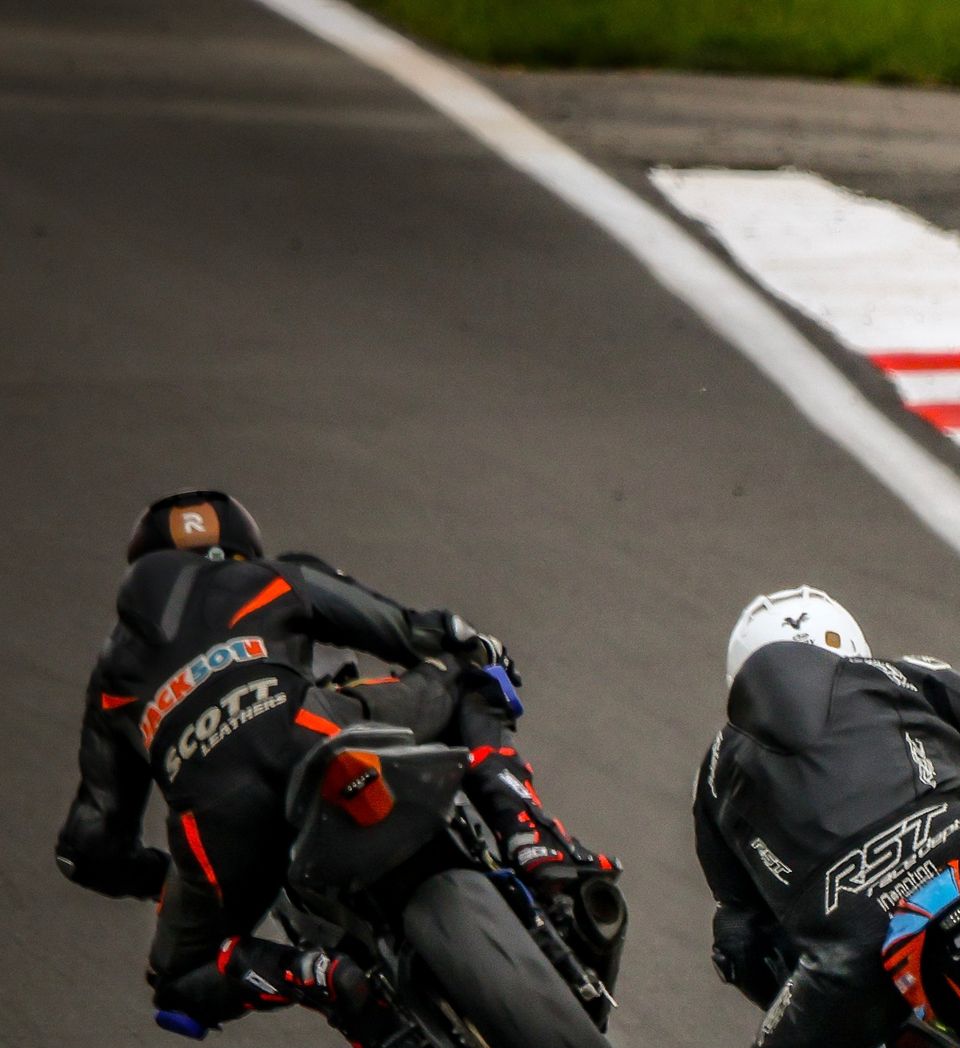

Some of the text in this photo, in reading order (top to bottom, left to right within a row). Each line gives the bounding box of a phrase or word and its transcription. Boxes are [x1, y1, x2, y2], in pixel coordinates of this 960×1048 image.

[183, 512, 206, 534] R
[164, 677, 279, 784] SCOTT
[201, 692, 287, 757] LEATHERS
[825, 802, 948, 915] RST
